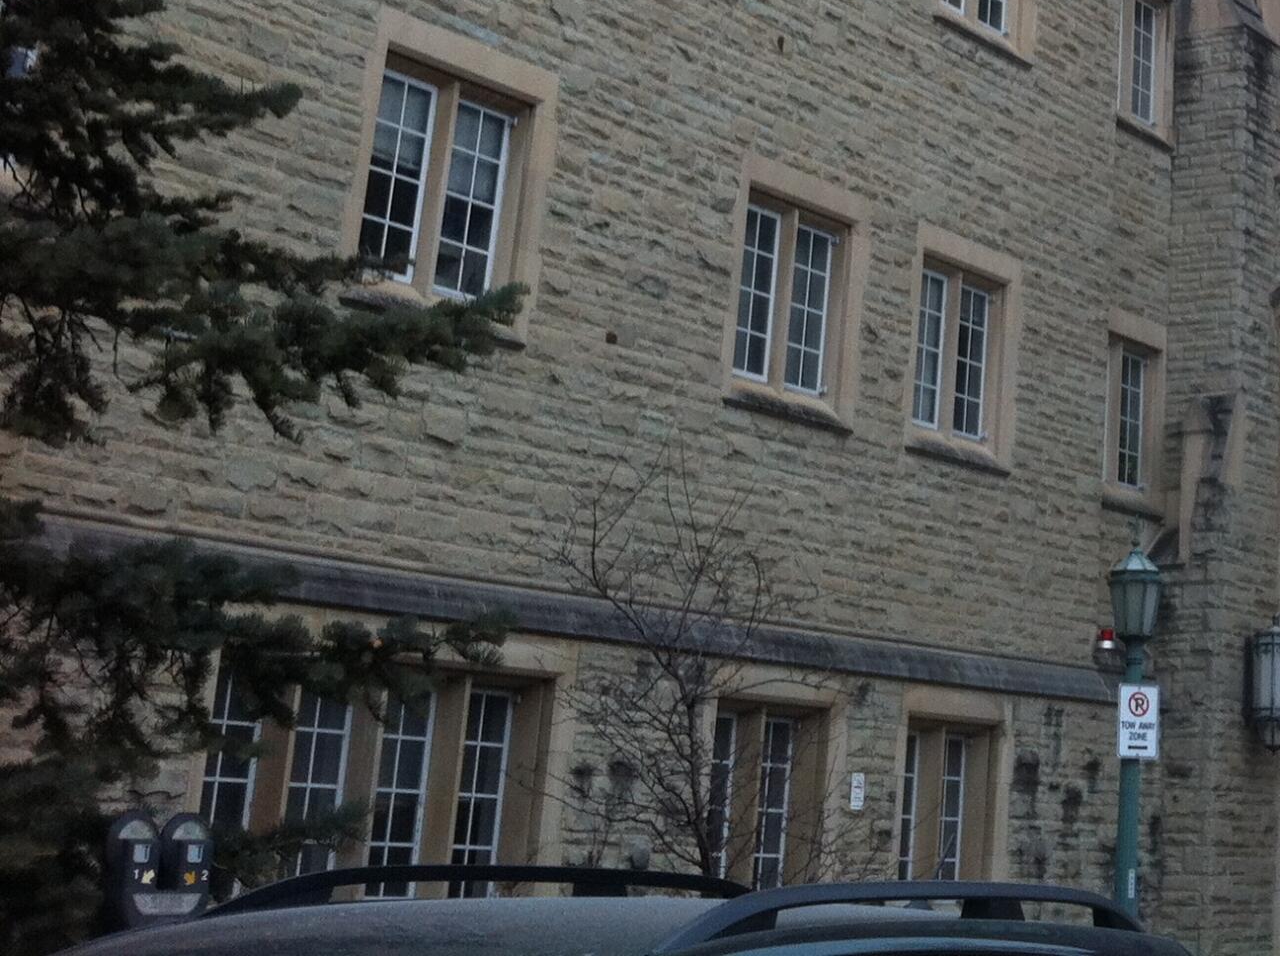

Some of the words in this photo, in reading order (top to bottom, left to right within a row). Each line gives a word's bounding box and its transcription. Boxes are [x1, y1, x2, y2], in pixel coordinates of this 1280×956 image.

[1121, 721, 1136, 730] TOW
[1128, 731, 1147, 741] ZONE
[133, 868, 140, 880] 1
[200, 869, 209, 881] 2
